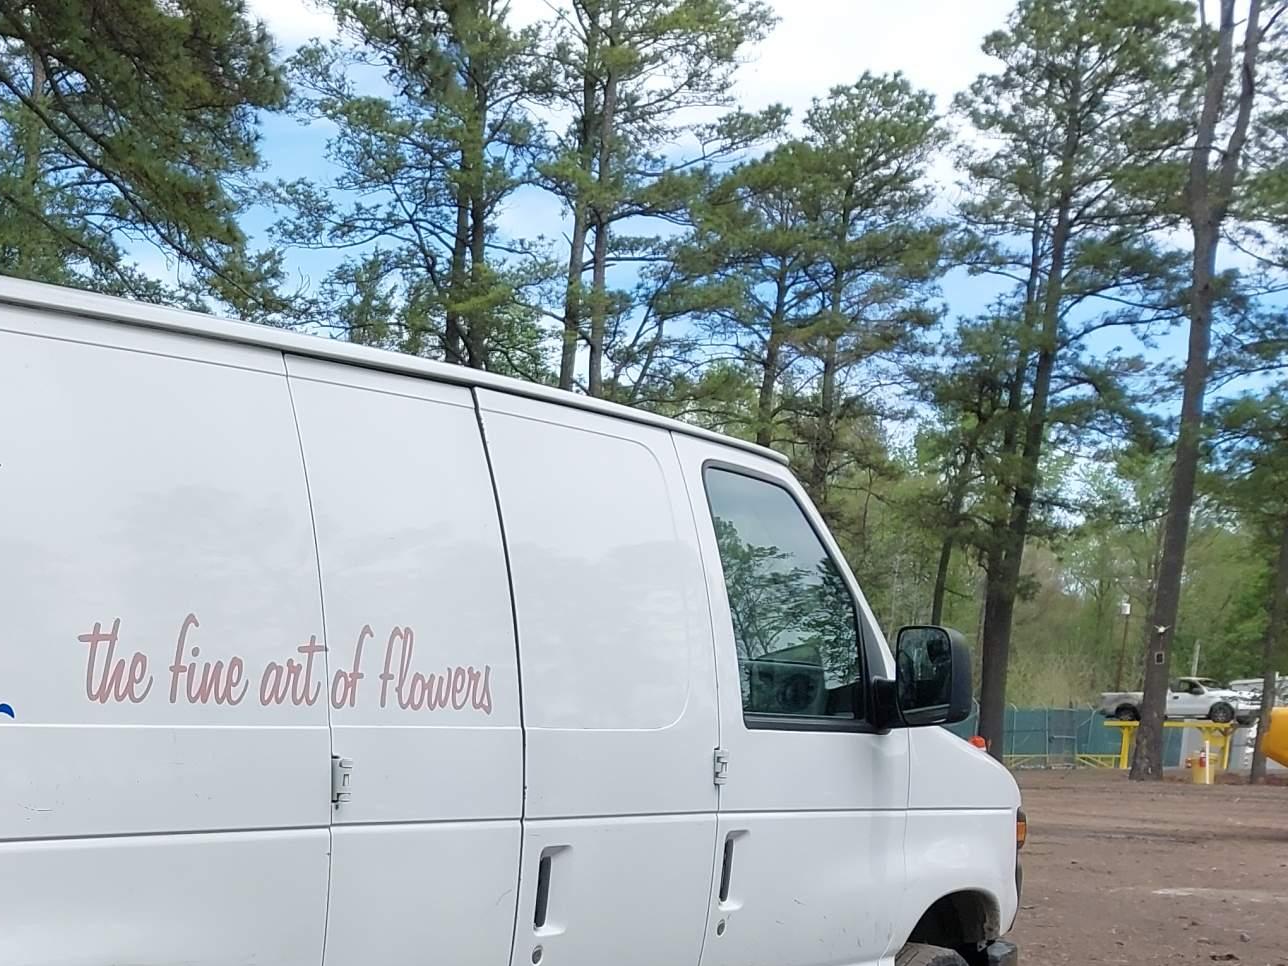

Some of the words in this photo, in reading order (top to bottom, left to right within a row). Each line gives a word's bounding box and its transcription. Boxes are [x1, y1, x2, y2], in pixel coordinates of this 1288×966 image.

[78, 617, 153, 704] the
[169, 613, 249, 705] fine
[259, 634, 329, 707] art
[331, 624, 374, 710] of
[379, 624, 492, 715] flowers
